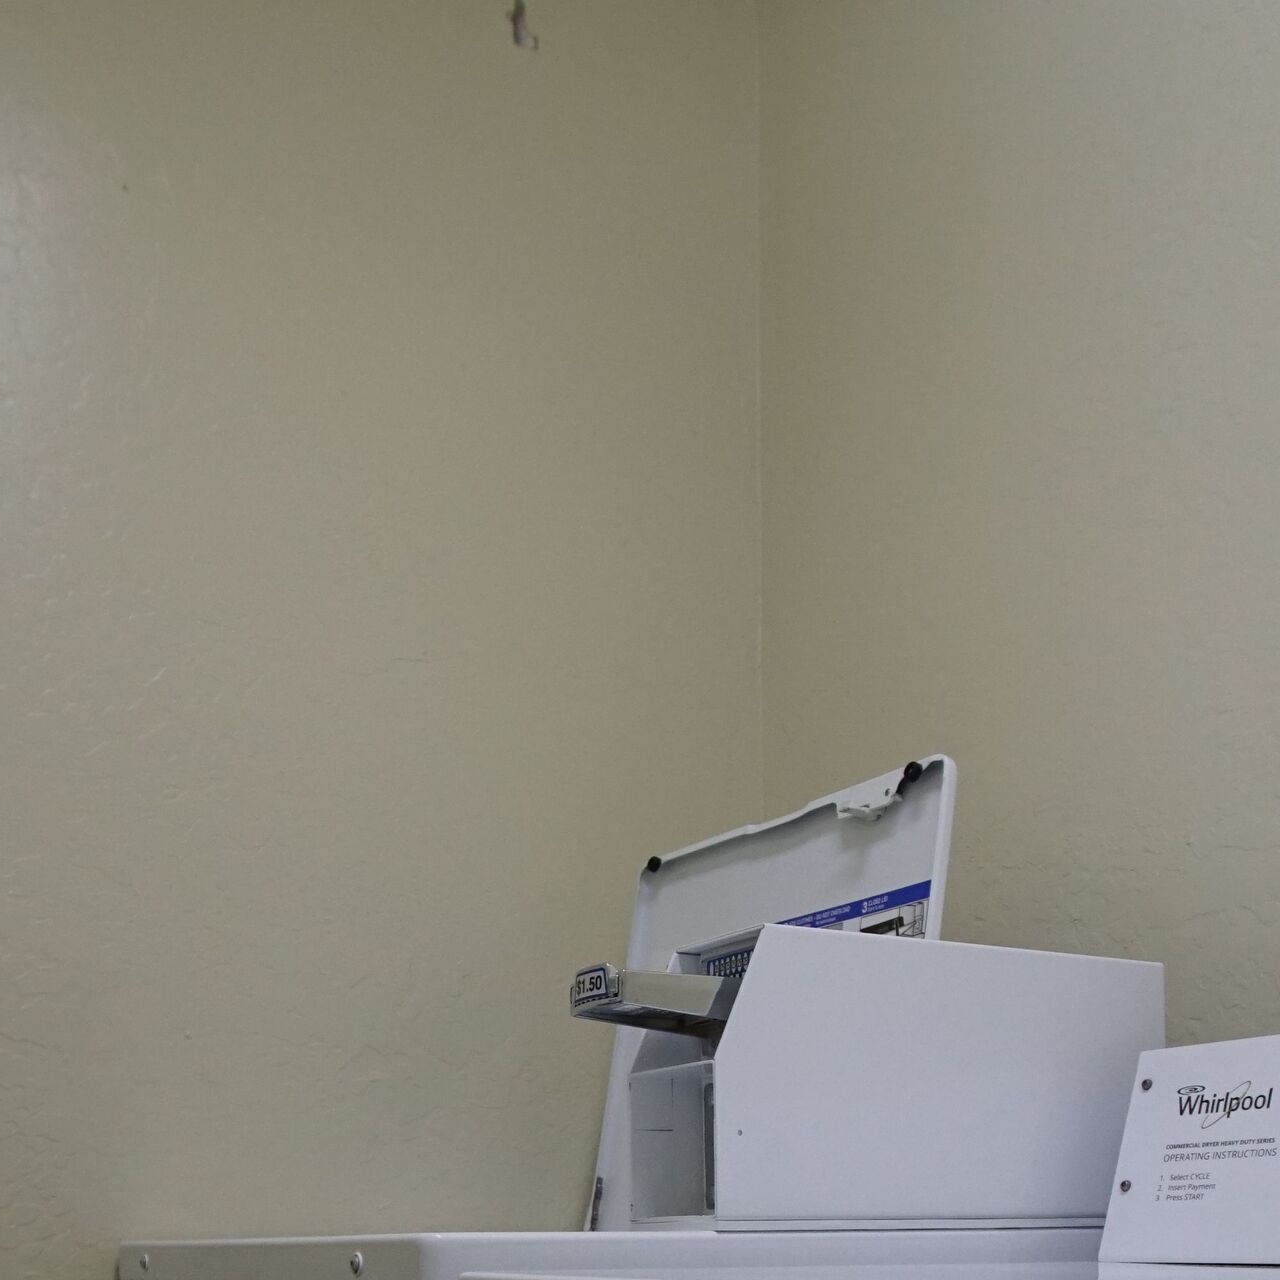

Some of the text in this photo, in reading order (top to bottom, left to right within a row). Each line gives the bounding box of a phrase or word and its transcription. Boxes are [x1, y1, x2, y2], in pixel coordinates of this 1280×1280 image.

[577, 974, 603, 996] $1.50
[1178, 1087, 1273, 1118] Whirlpool
[1165, 1142, 1201, 1150] COMMERCIAL
[1256, 1137, 1275, 1145] SERIES
[1163, 1148, 1278, 1163] OPERATING INSTRUCTIONS
[1190, 1172, 1211, 1180] CYCLE
[1187, 1183, 1216, 1192] Payment
[1184, 1193, 1204, 1201] START
